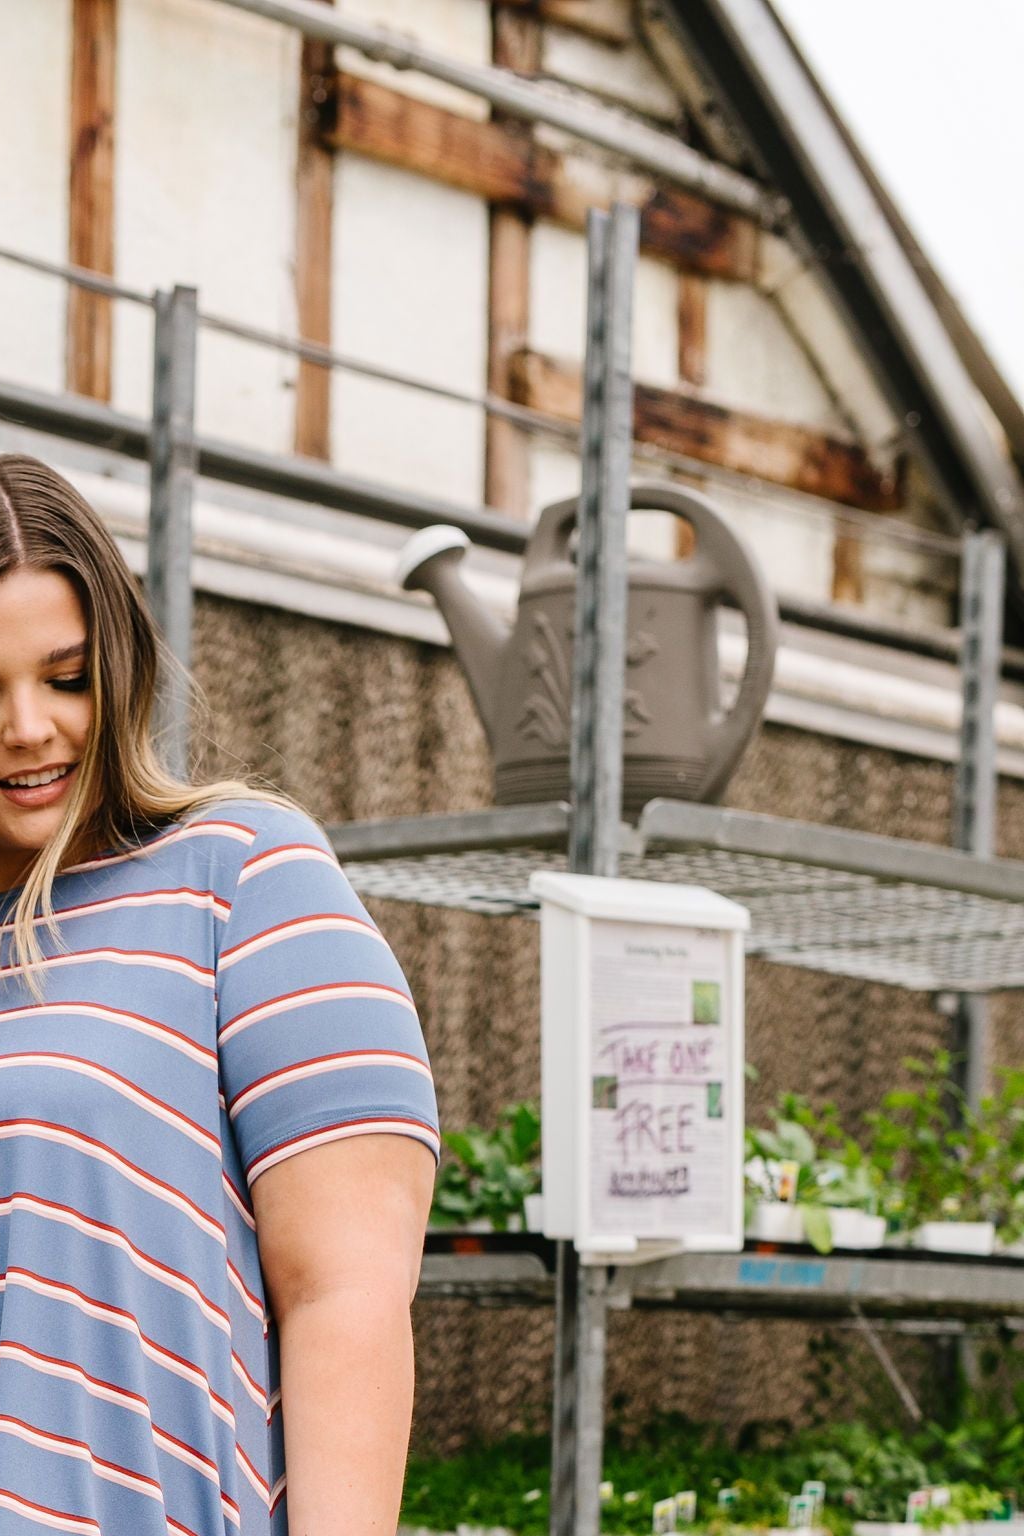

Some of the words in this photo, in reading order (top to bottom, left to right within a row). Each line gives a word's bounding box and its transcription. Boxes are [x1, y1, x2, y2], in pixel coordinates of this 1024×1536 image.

[598, 1037, 660, 1074] TAKE
[670, 1037, 713, 1074] ONE
[613, 1099, 696, 1164] FREE
